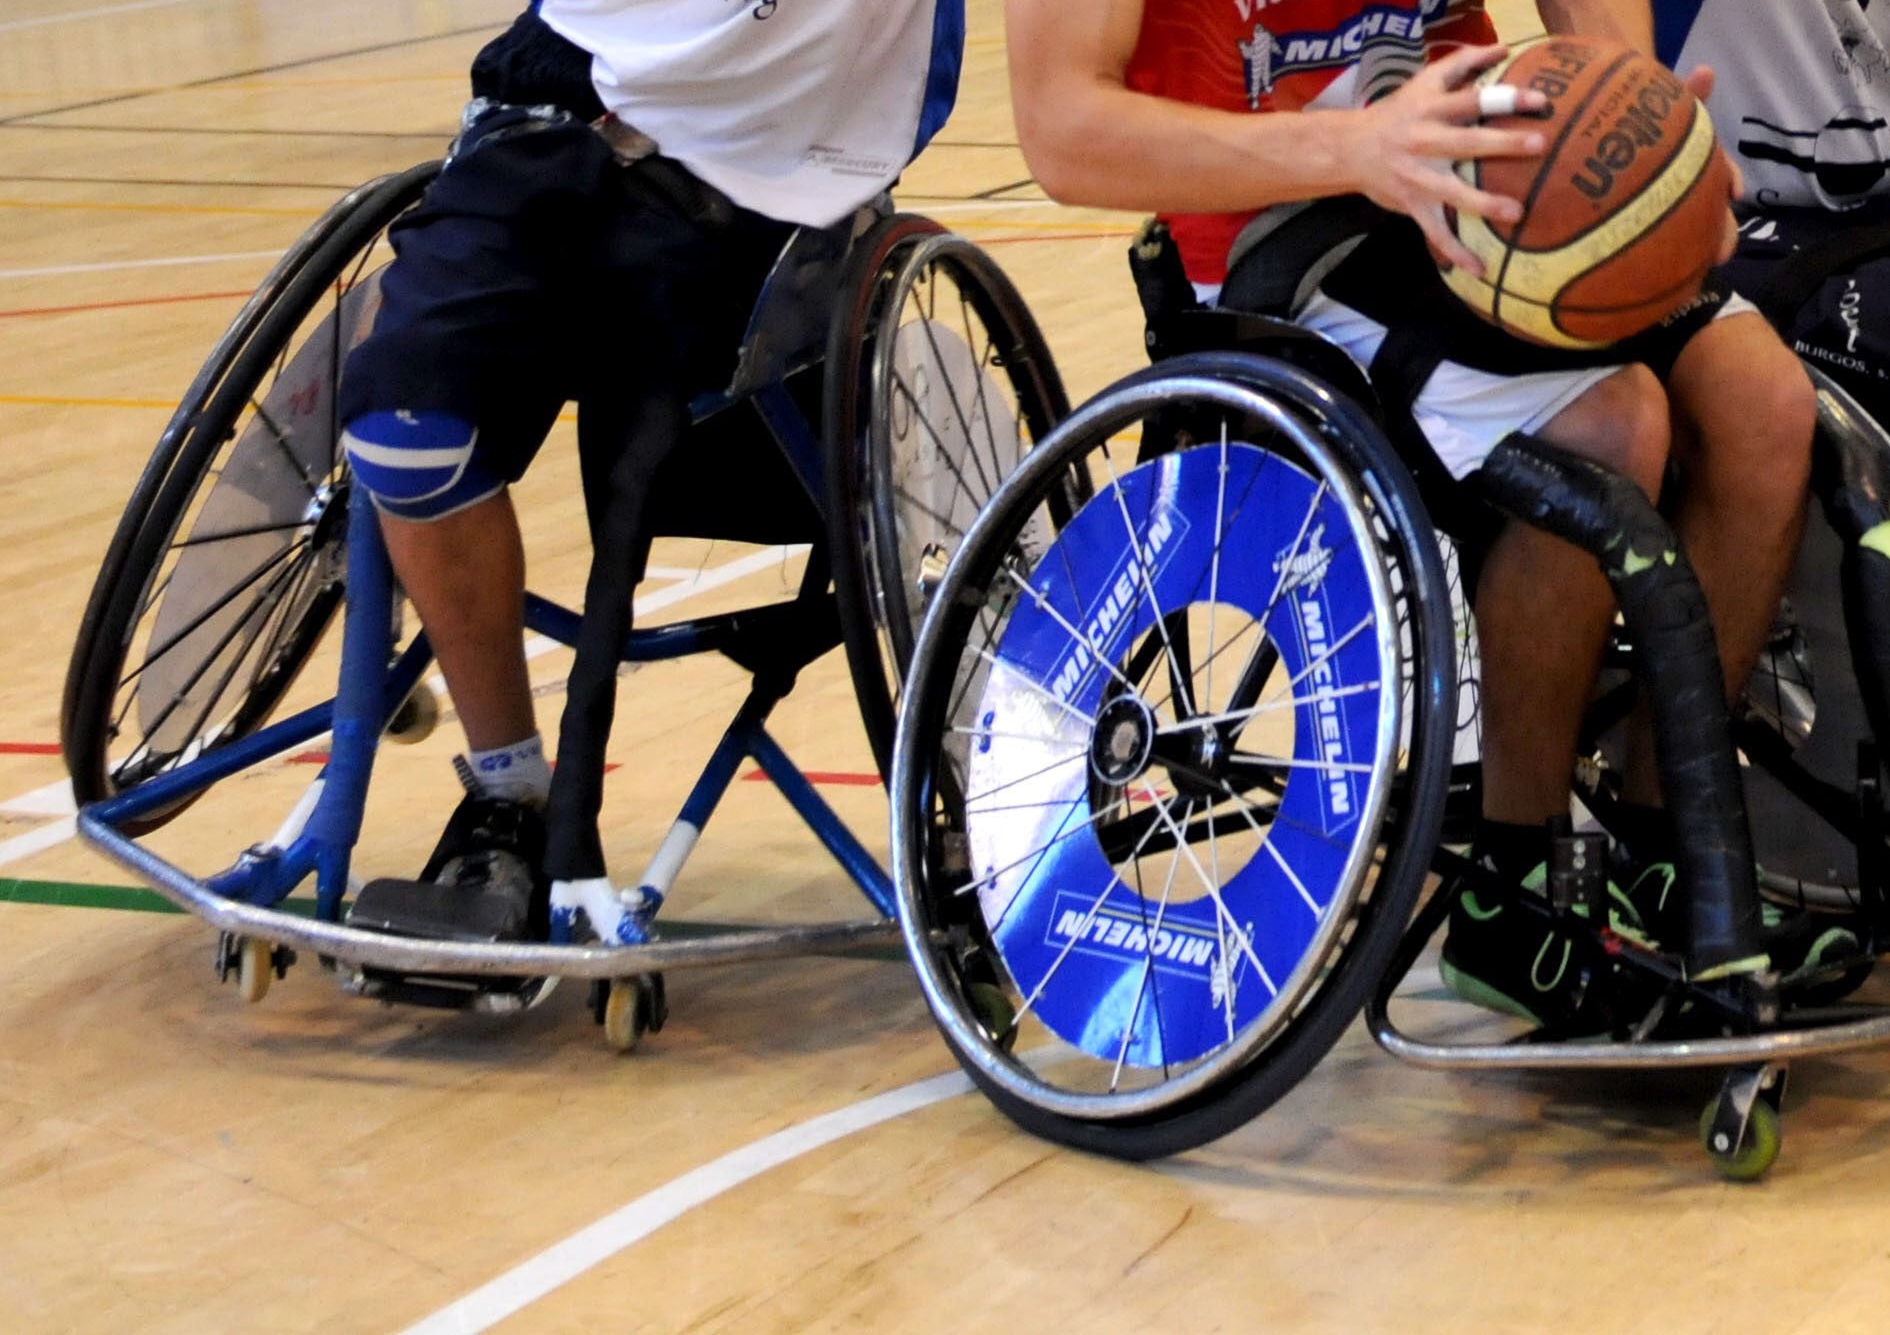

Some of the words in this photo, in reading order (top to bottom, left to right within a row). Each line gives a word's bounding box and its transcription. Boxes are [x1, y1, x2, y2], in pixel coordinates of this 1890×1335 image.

[1053, 512, 1174, 703] MICHELIN
[1300, 600, 1350, 817] MICHELIN
[1057, 908, 1216, 964] MICHELIN
